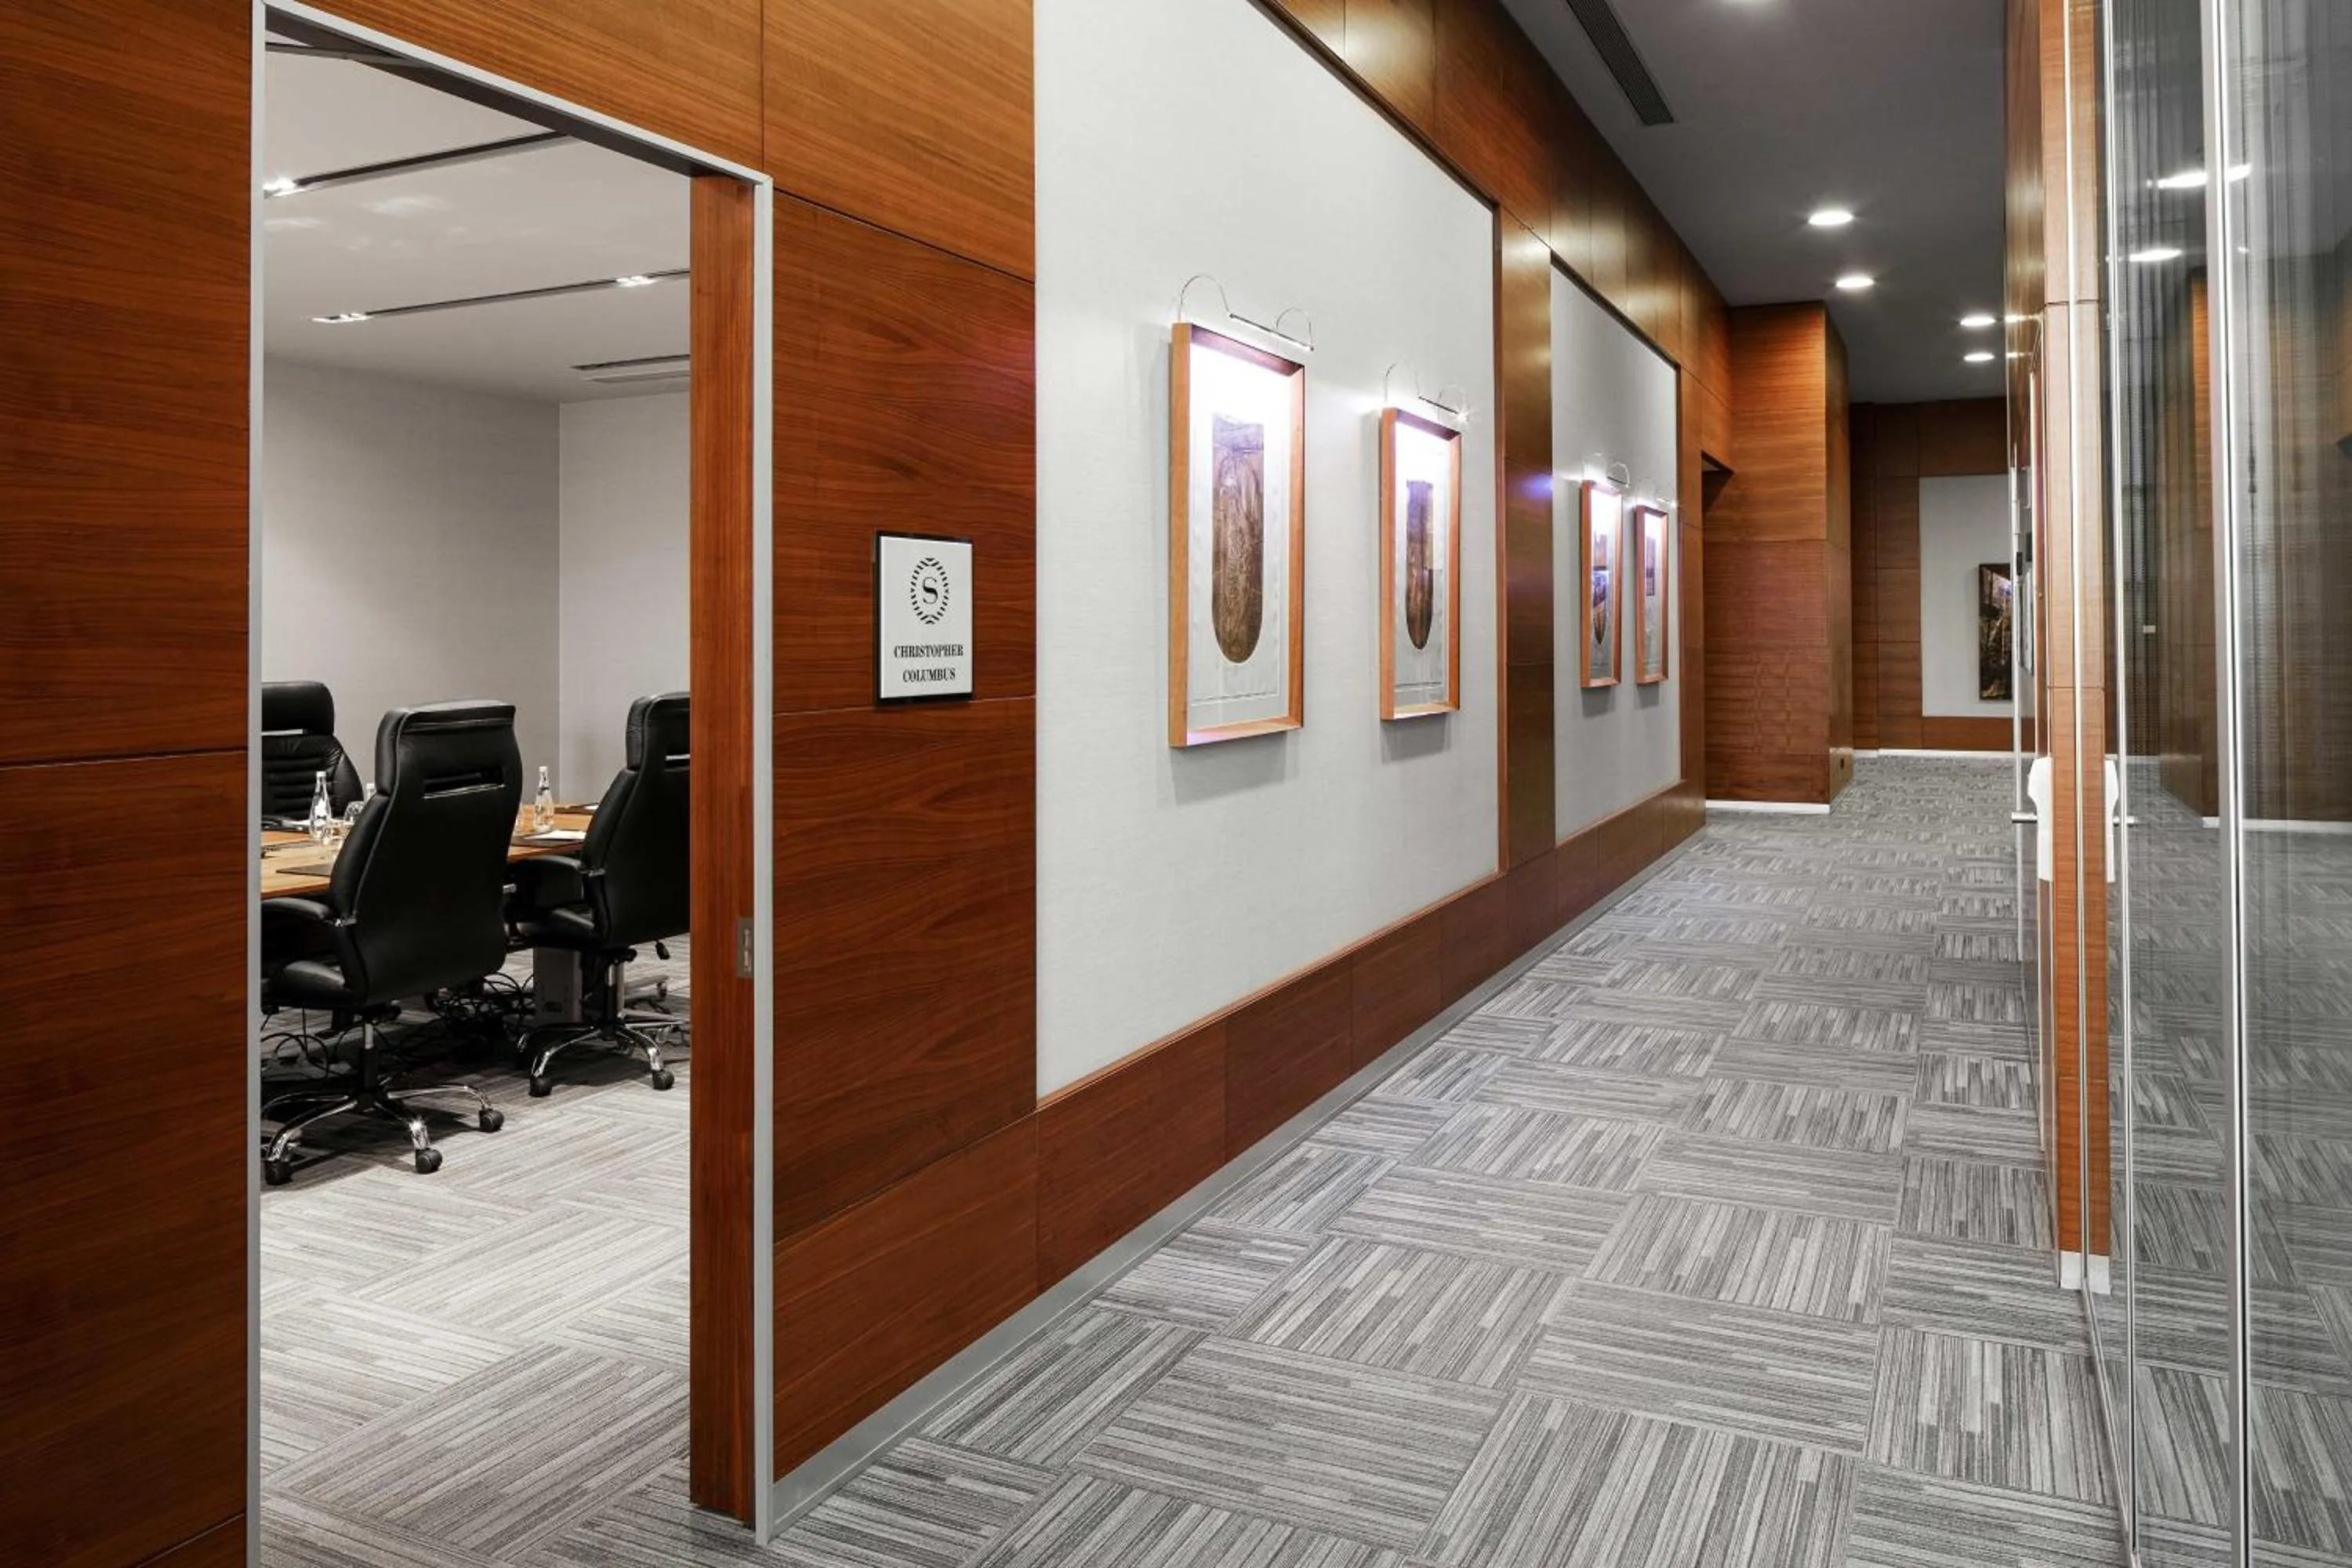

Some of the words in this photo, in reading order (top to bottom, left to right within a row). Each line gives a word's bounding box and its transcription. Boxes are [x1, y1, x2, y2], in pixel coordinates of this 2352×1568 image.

[921, 576, 938, 604] S
[894, 644, 964, 658] CHRISTOPHER
[902, 667, 956, 683] COLUMBUS
